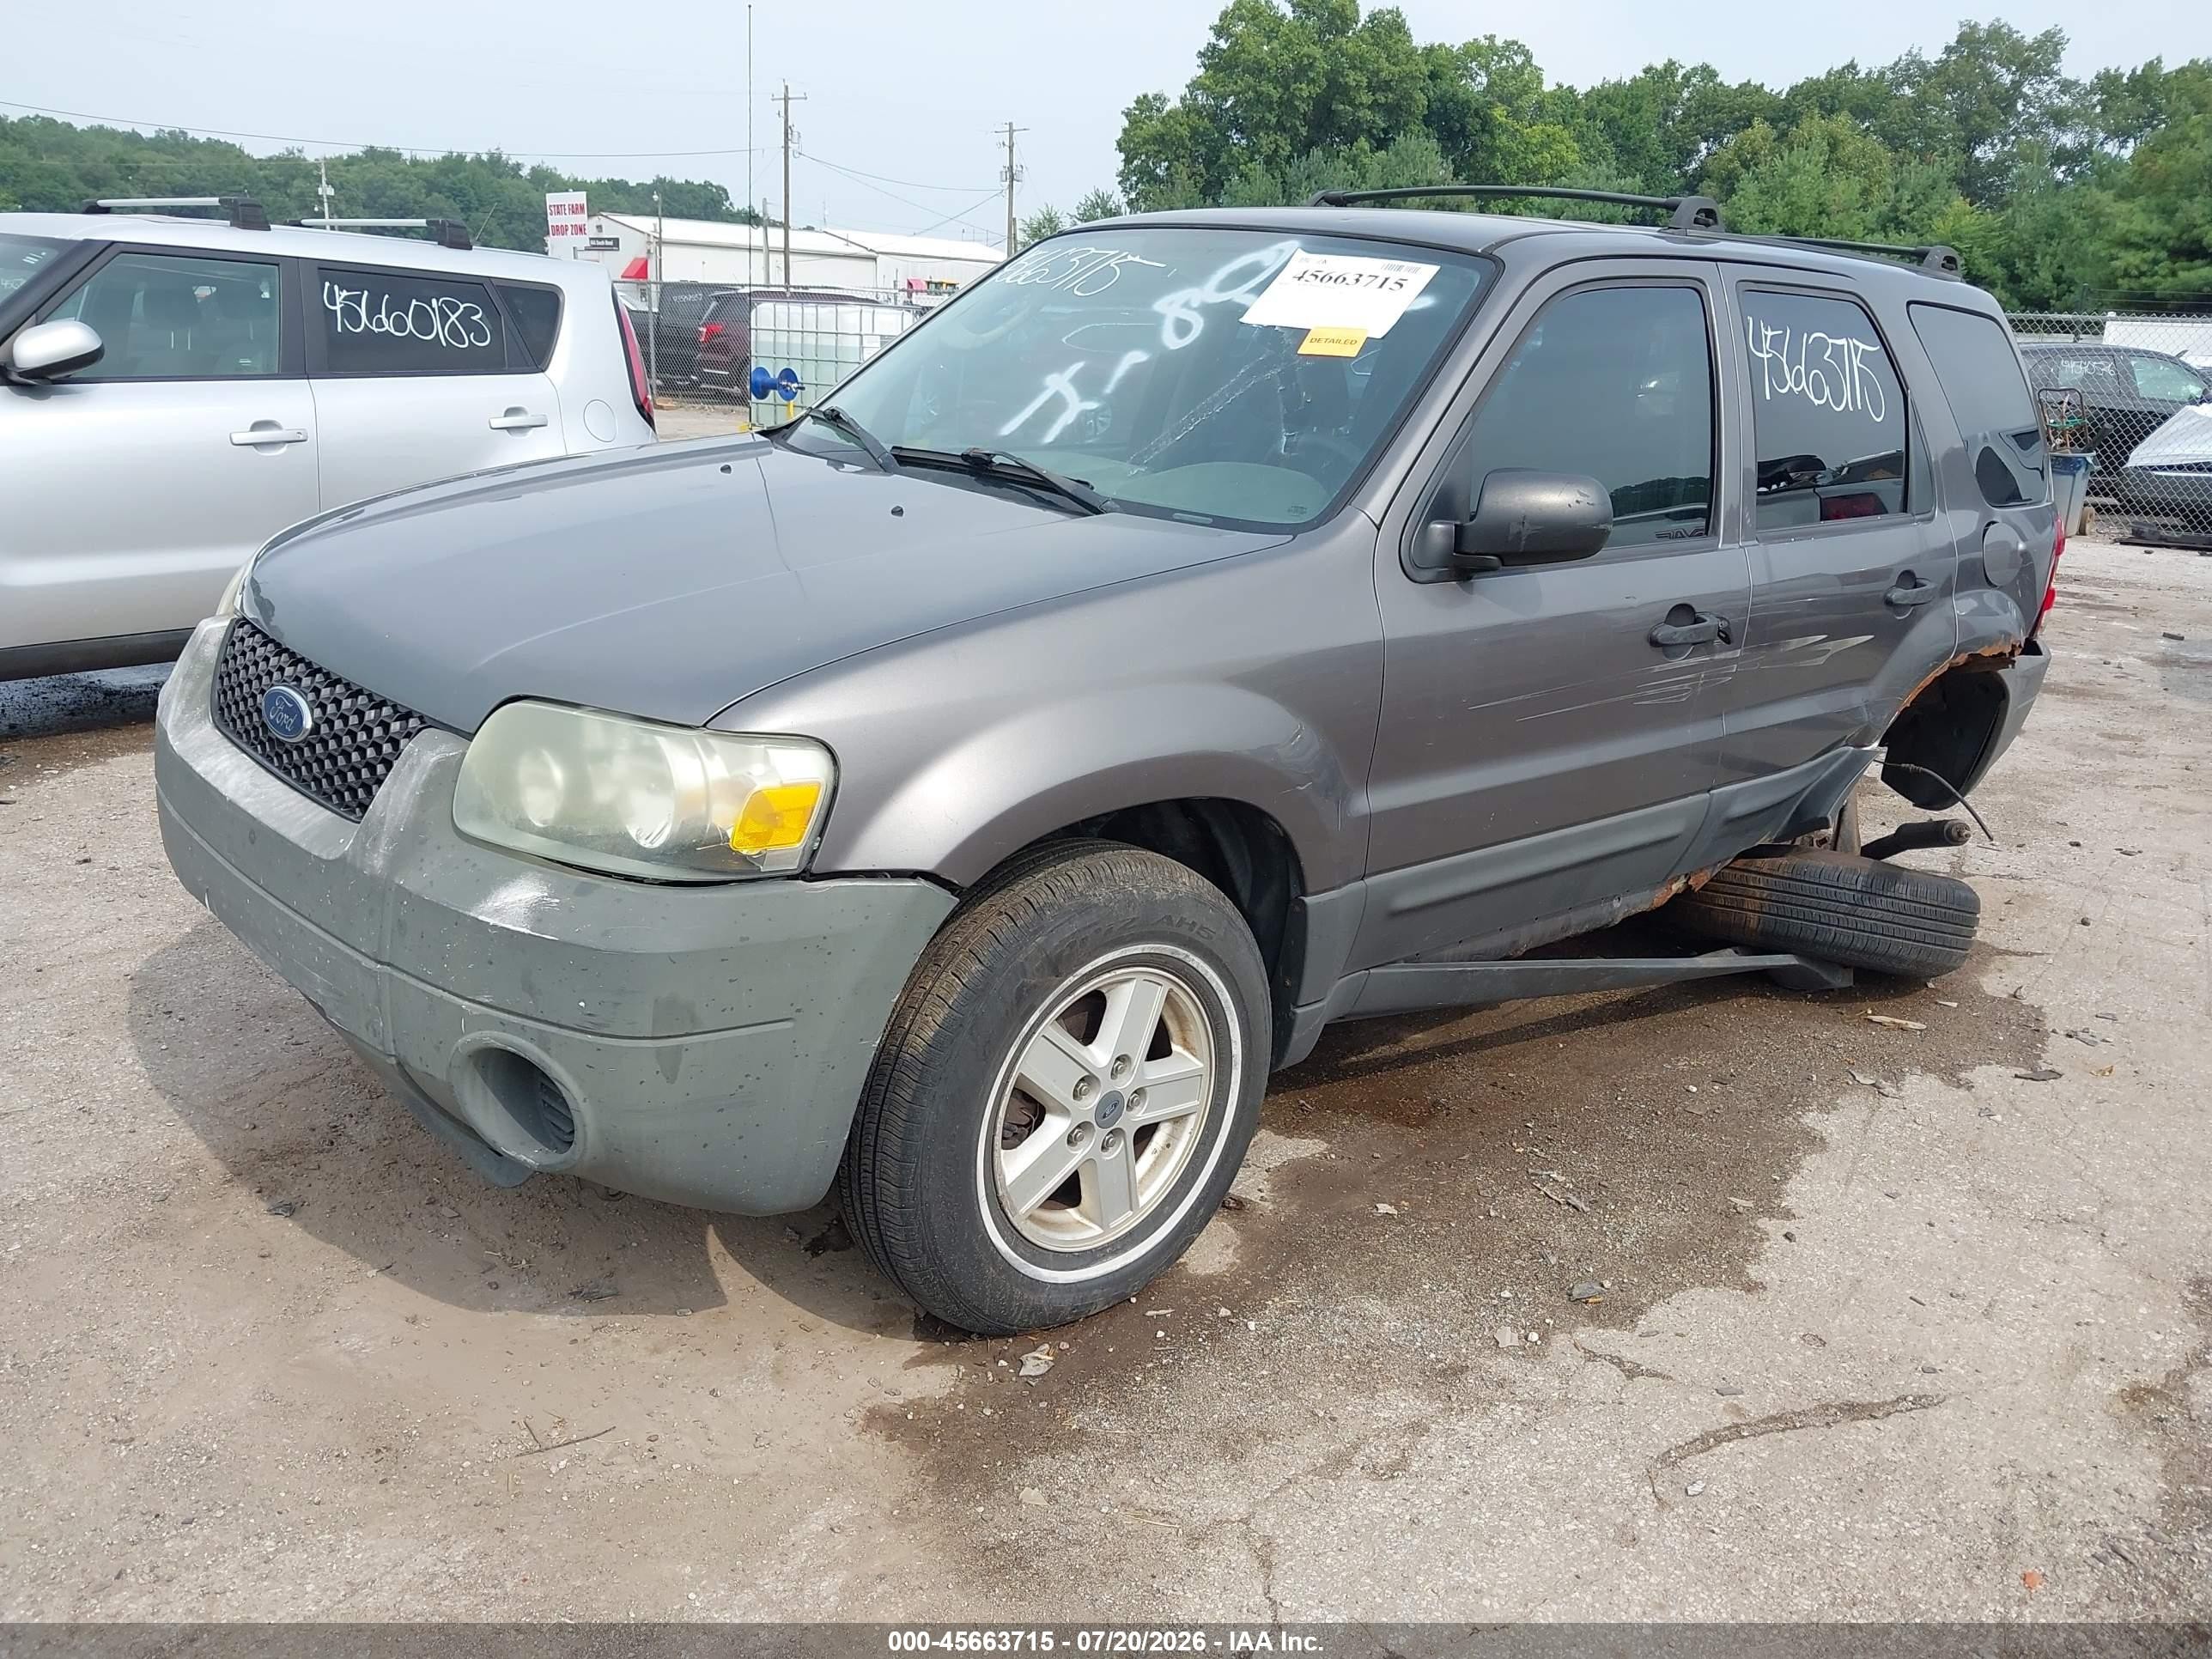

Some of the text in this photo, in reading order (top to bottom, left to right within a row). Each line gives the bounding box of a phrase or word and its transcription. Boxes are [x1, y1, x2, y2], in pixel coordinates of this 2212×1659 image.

[549, 203, 586, 216] STATE FARM
[550, 223, 587, 236] DROP ZONE
[1292, 268, 1409, 293] 45663715
[324, 281, 491, 348] 45660183
[1309, 337, 1358, 345] DETAILED
[1747, 315, 1885, 422] 45663715
[270, 696, 297, 732] Ford
